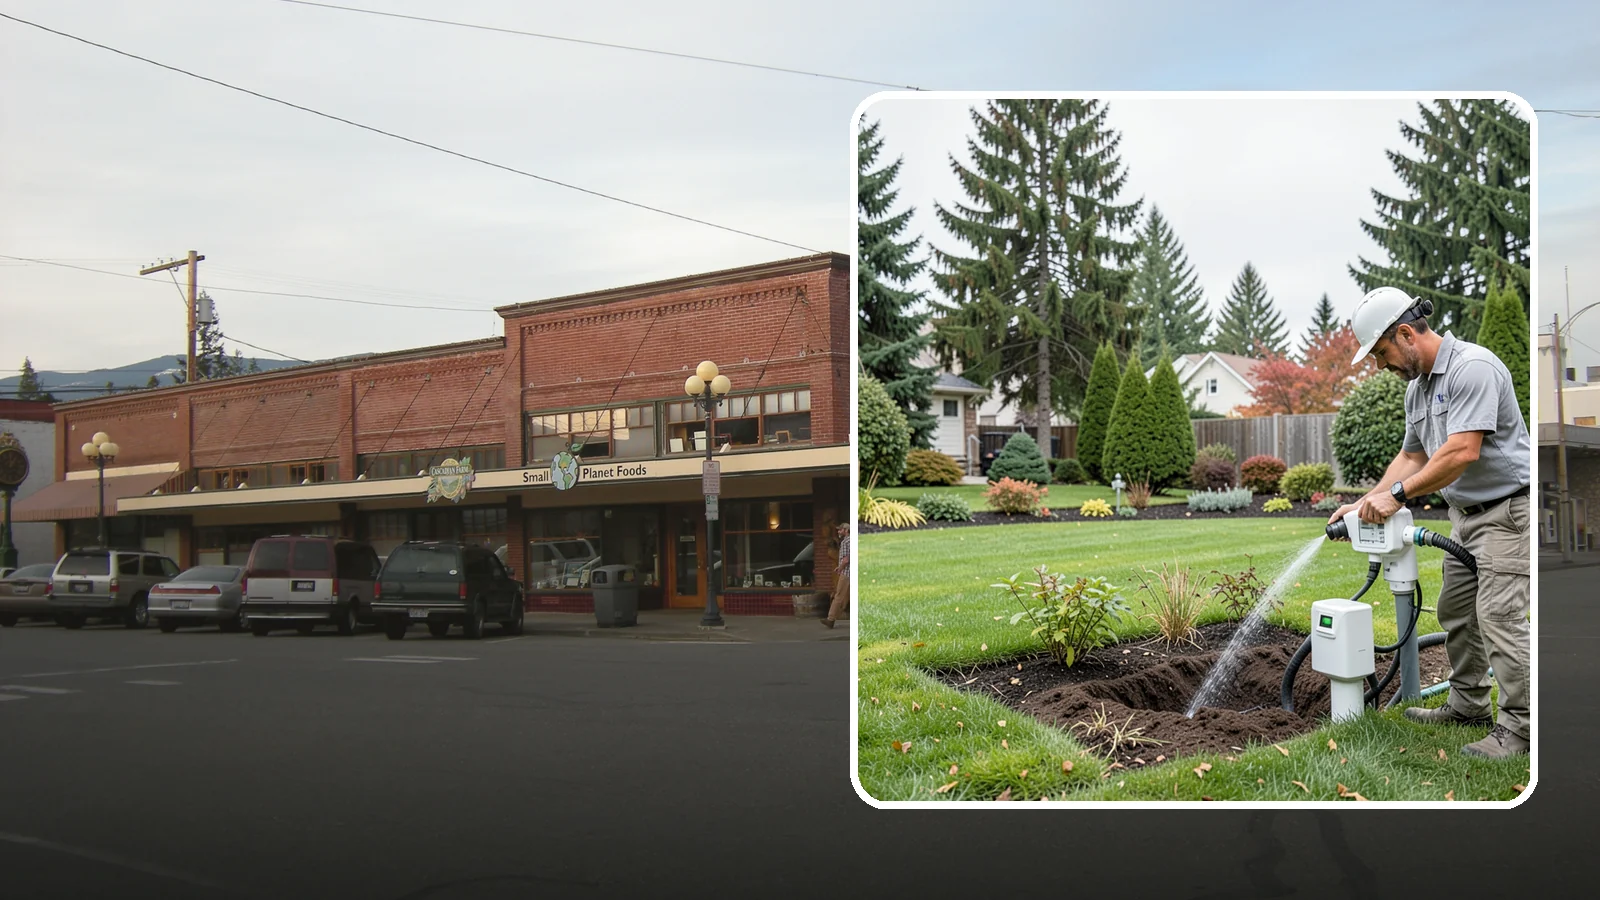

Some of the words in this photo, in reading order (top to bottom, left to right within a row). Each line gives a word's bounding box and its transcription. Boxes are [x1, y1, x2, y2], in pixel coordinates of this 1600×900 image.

[522, 471, 548, 483] Small
[582, 467, 614, 479] Planet
[616, 464, 647, 477] Foods
